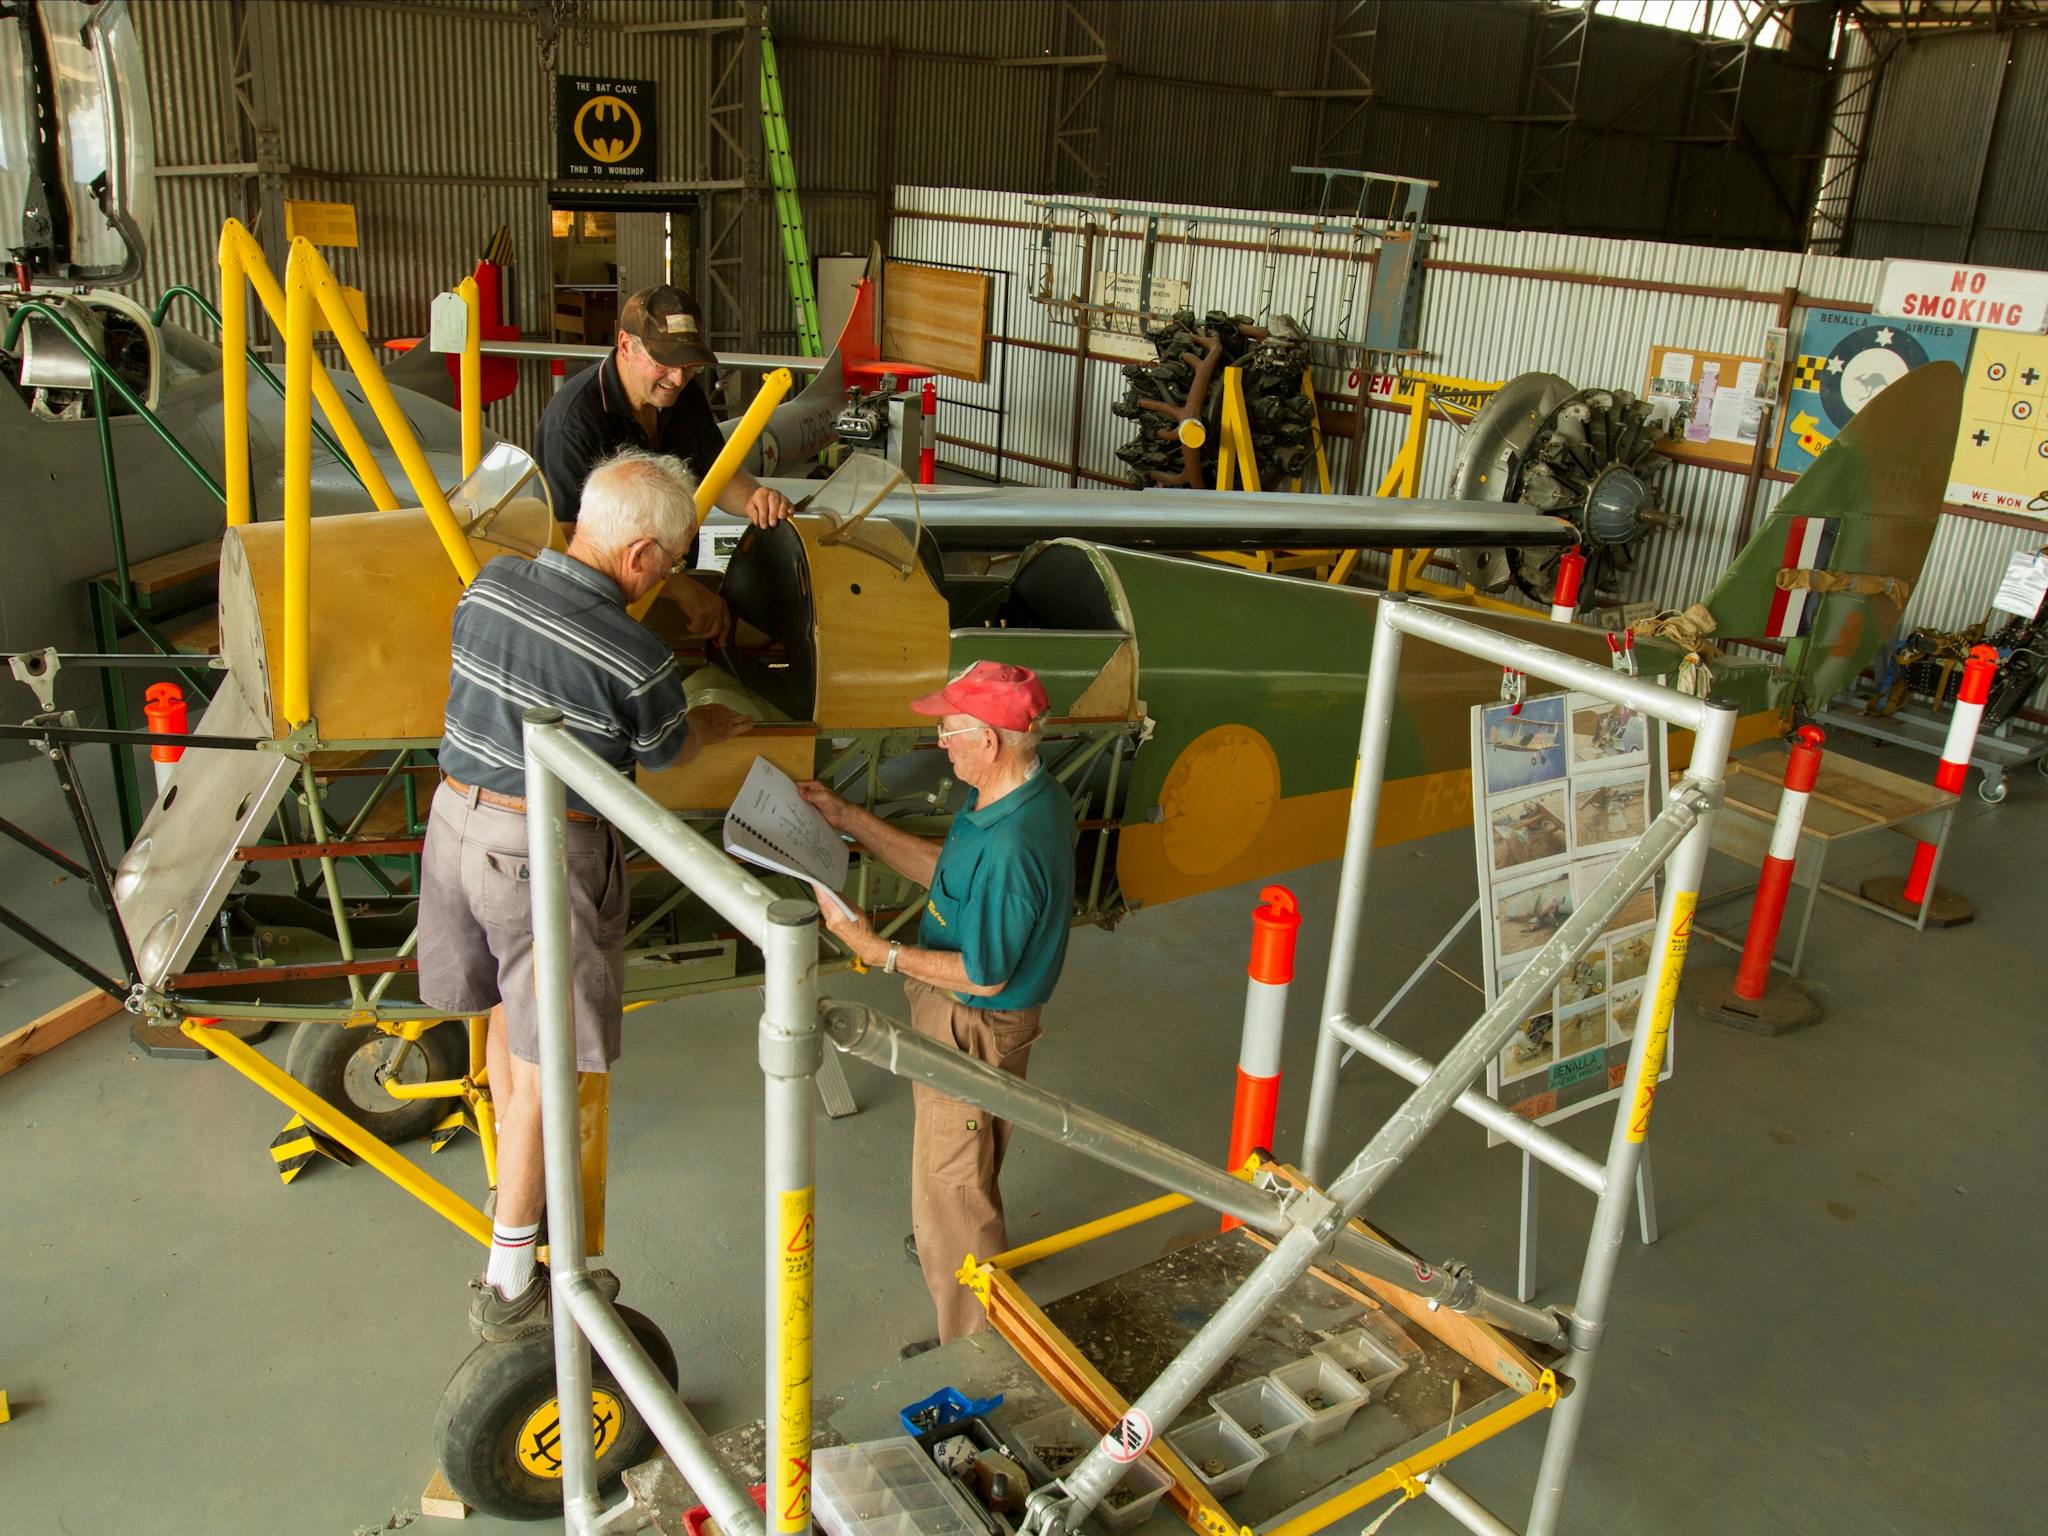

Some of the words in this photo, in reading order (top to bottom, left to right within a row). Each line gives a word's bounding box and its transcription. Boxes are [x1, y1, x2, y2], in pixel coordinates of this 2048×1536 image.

[576, 82, 590, 91] THE
[596, 83, 611, 92] BAT
[615, 84, 638, 94] CAVE
[570, 165, 588, 174] THRU
[594, 166, 602, 174] TO
[608, 166, 644, 176] WORKSHOP
[1950, 270, 1986, 295] NO
[1902, 293, 2023, 326] SMOKING
[1820, 313, 1868, 328] BENALLA
[1904, 323, 1954, 338] AIRFIELD
[1348, 369, 1394, 395] OEN
[1398, 376, 1491, 410] WNESDAY
[1972, 490, 1990, 502] WE
[1997, 495, 2023, 509] WON
[1553, 1053, 1598, 1079] BENALLA
